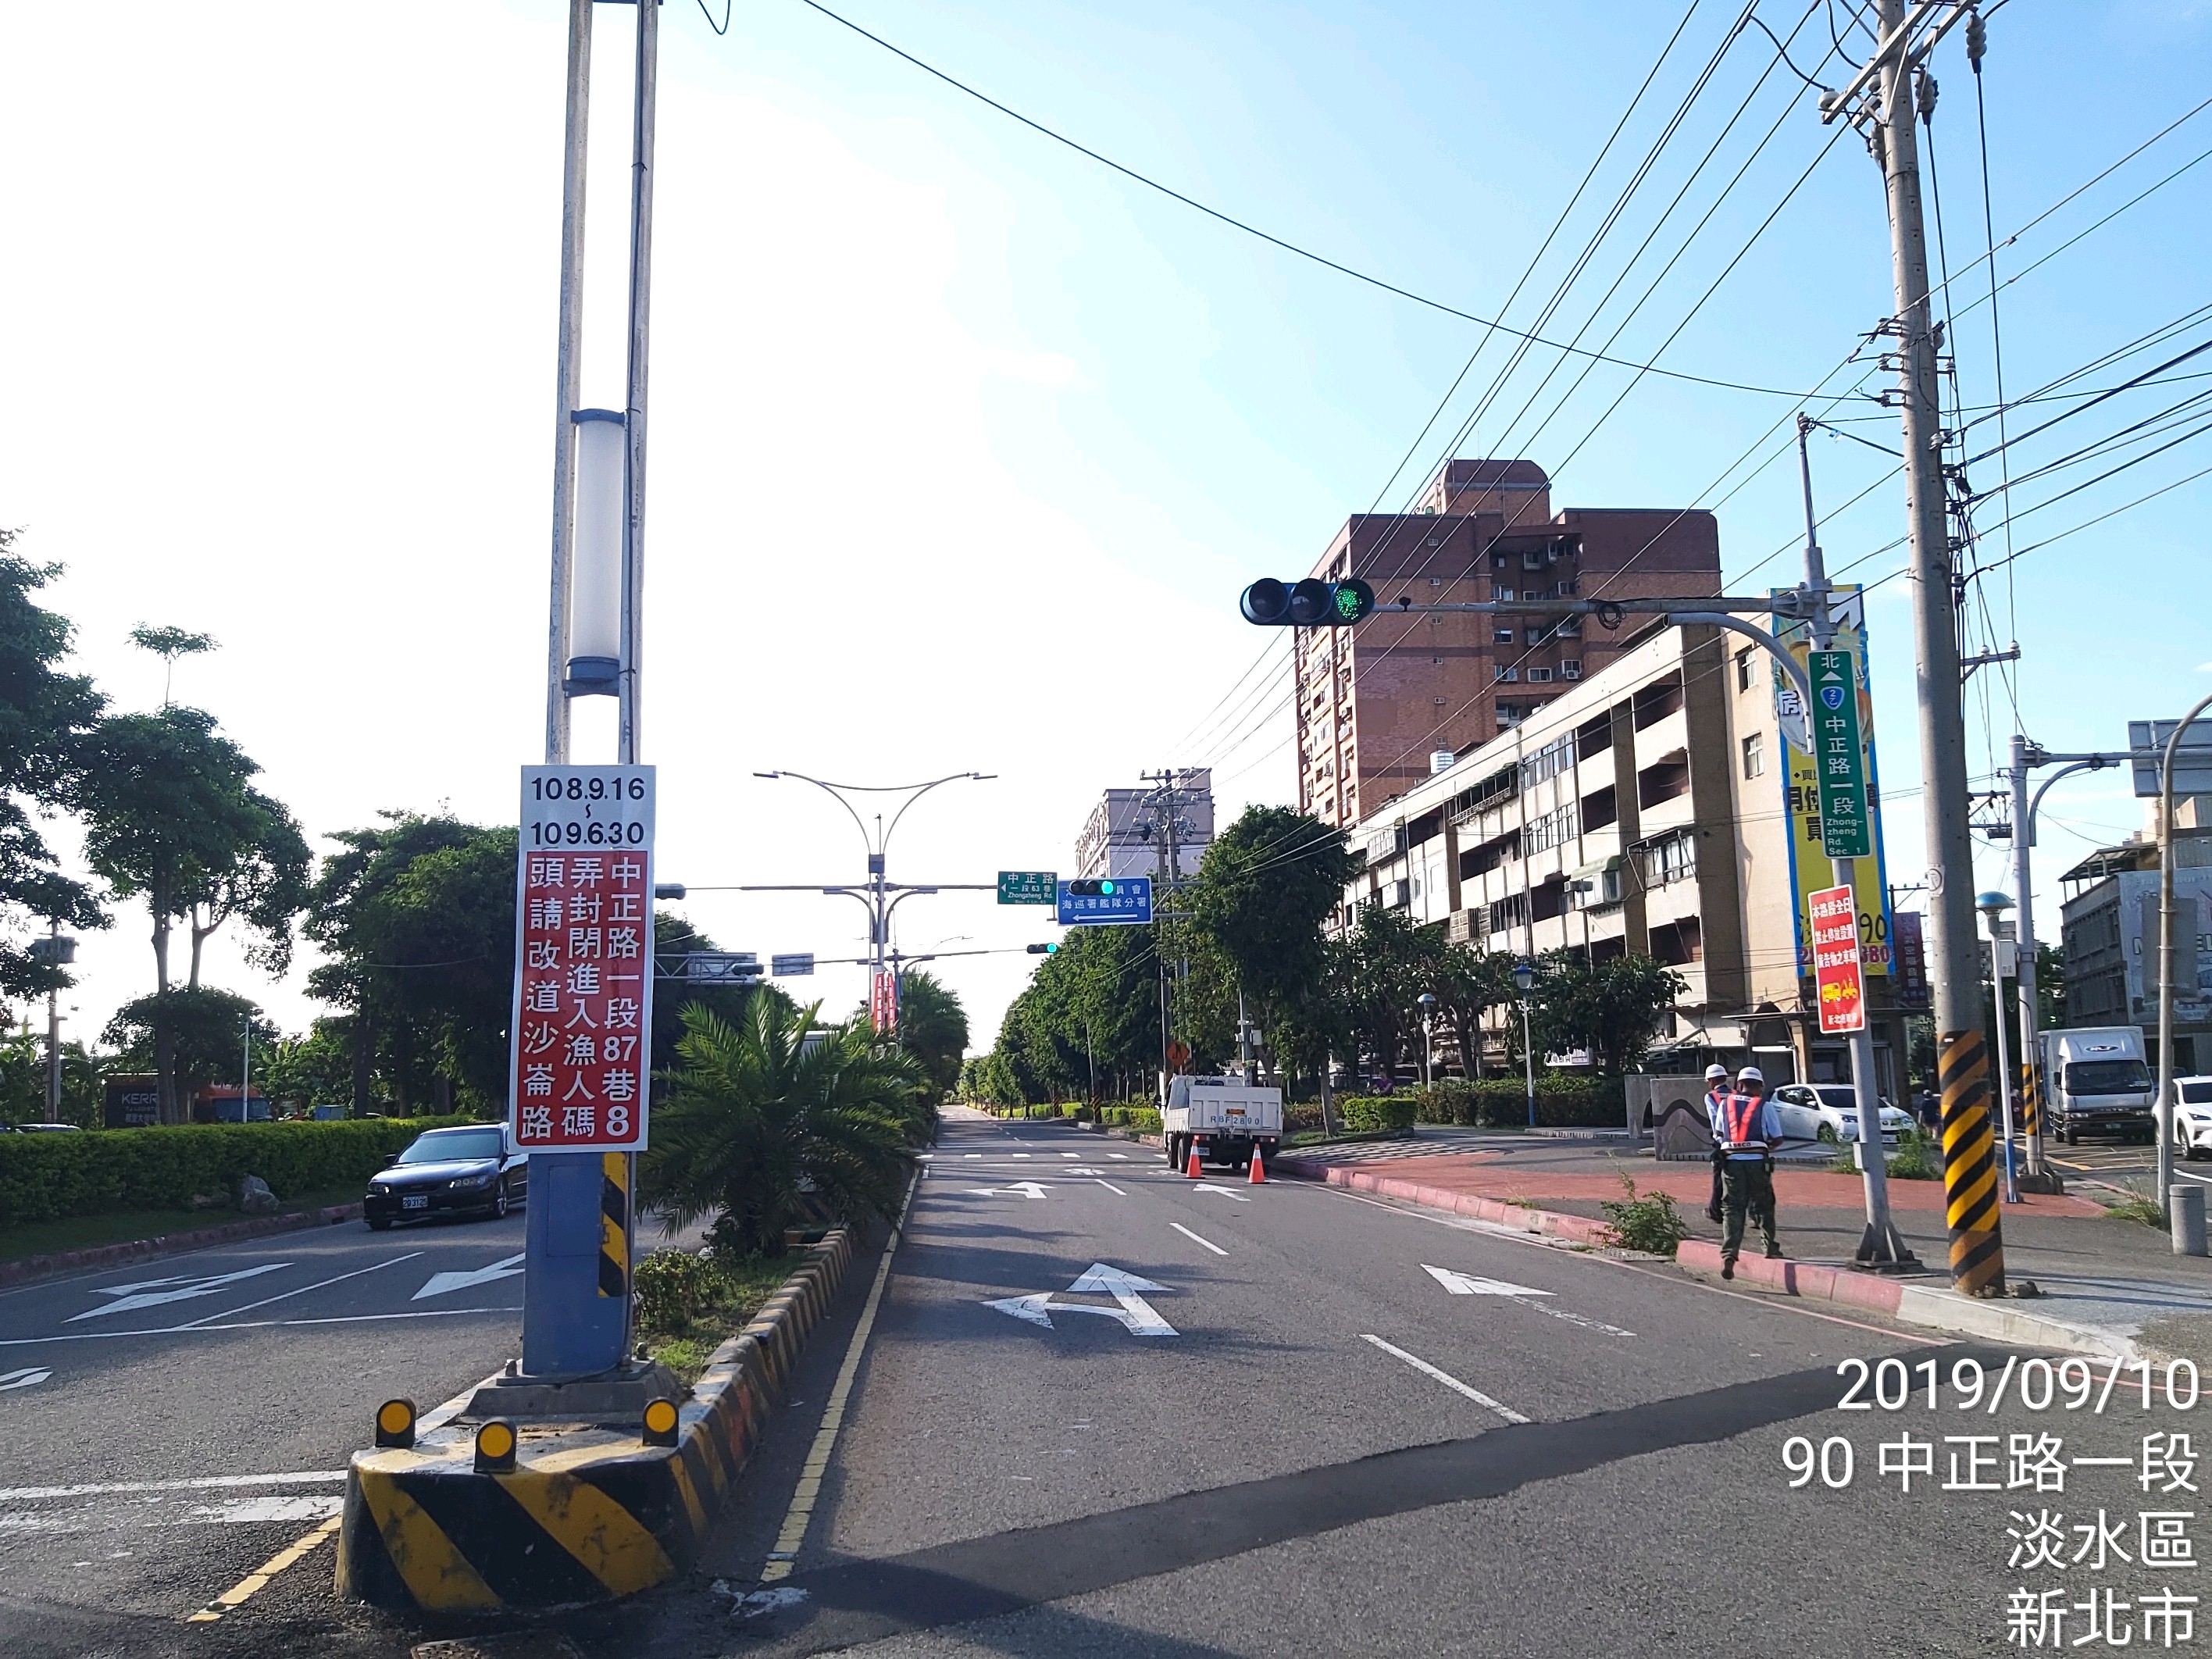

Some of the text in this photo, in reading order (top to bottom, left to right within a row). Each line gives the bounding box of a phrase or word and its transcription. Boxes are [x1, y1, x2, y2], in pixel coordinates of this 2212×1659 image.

[1821, 654, 1840, 669] 北
[1825, 715, 1856, 815] 中正路一段
[531, 777, 645, 801] 108.9.16
[530, 822, 644, 845] 109.6.30
[1008, 872, 1054, 883] 中正路
[520, 858, 565, 1140] 頭請改道沙崙路
[561, 858, 604, 1138] 弄封閉進入漁人碼
[601, 856, 642, 1138] 中正路一段87巷8
[122, 1094, 158, 1104] KERR
